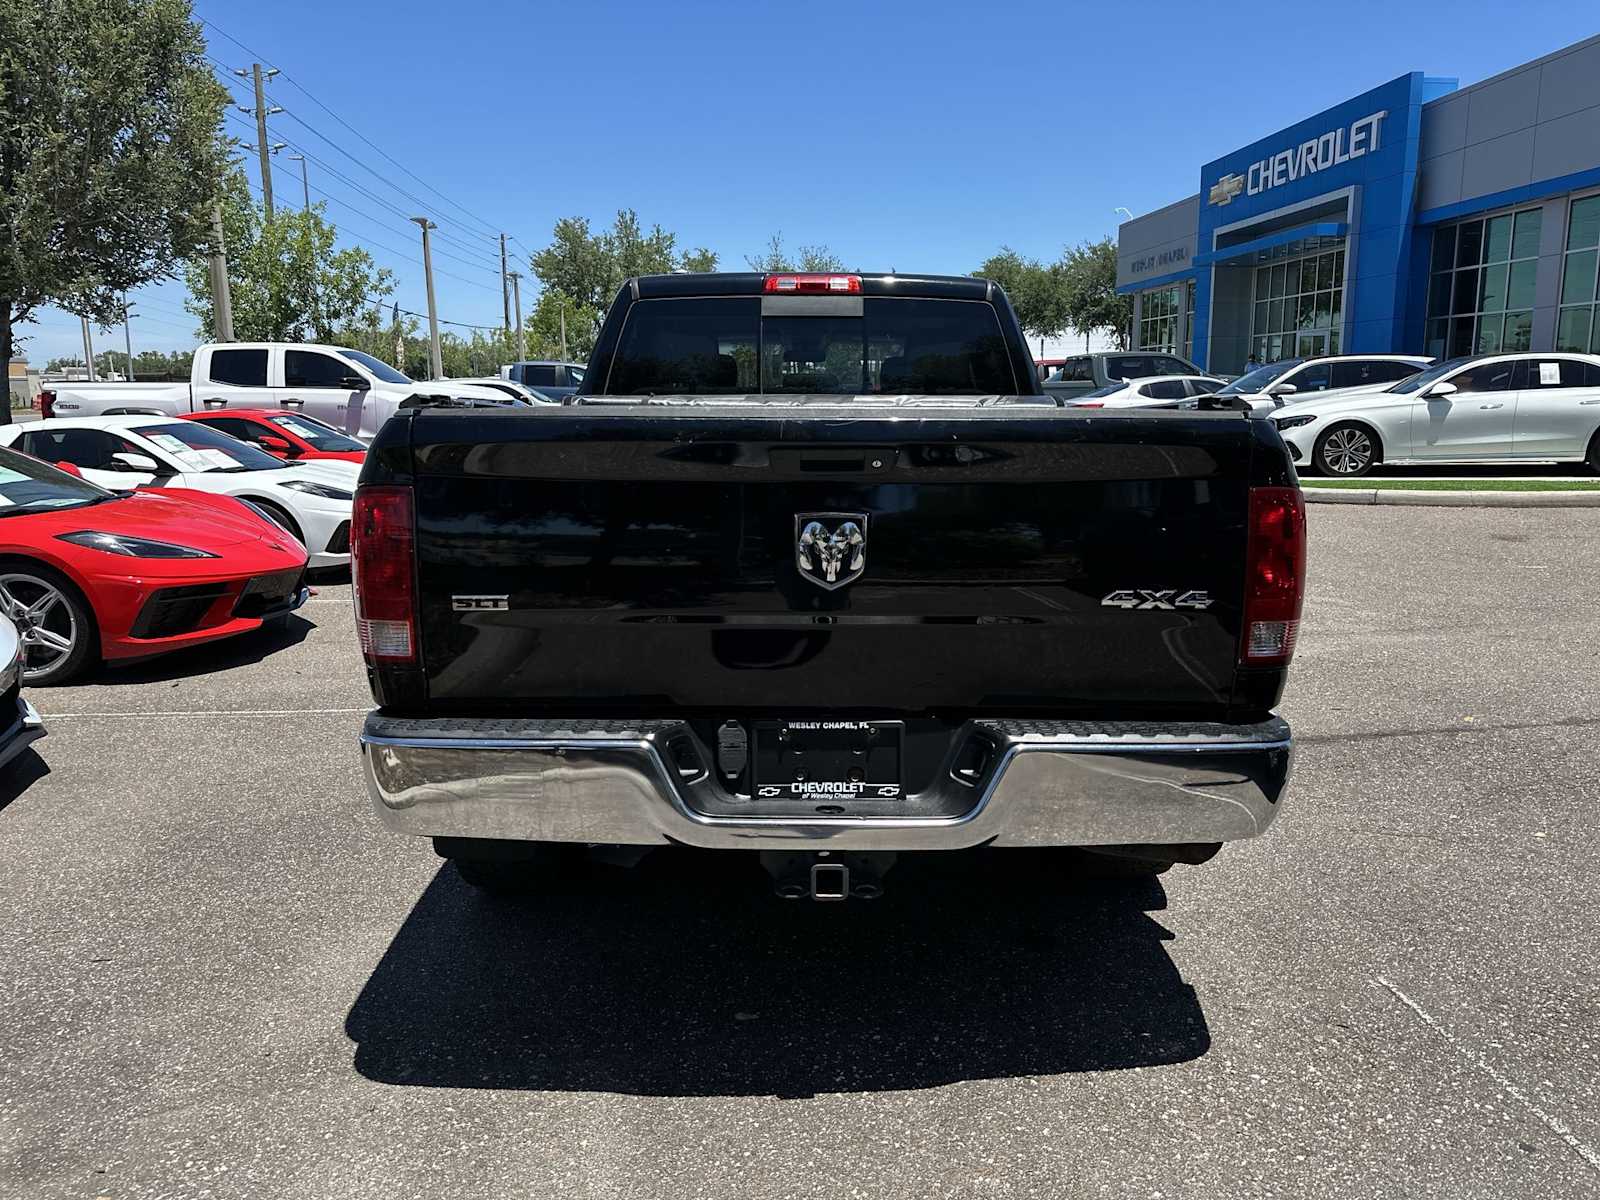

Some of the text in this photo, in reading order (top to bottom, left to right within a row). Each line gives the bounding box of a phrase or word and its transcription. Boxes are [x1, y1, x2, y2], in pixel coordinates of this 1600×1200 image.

[1247, 110, 1388, 196] CHEVROLET
[451, 594, 509, 611] SLT
[788, 721, 820, 729] WESLEY
[822, 721, 858, 730] CHAPEL,
[791, 782, 866, 793] CHEVROLET
[810, 792, 833, 800] Wesley
